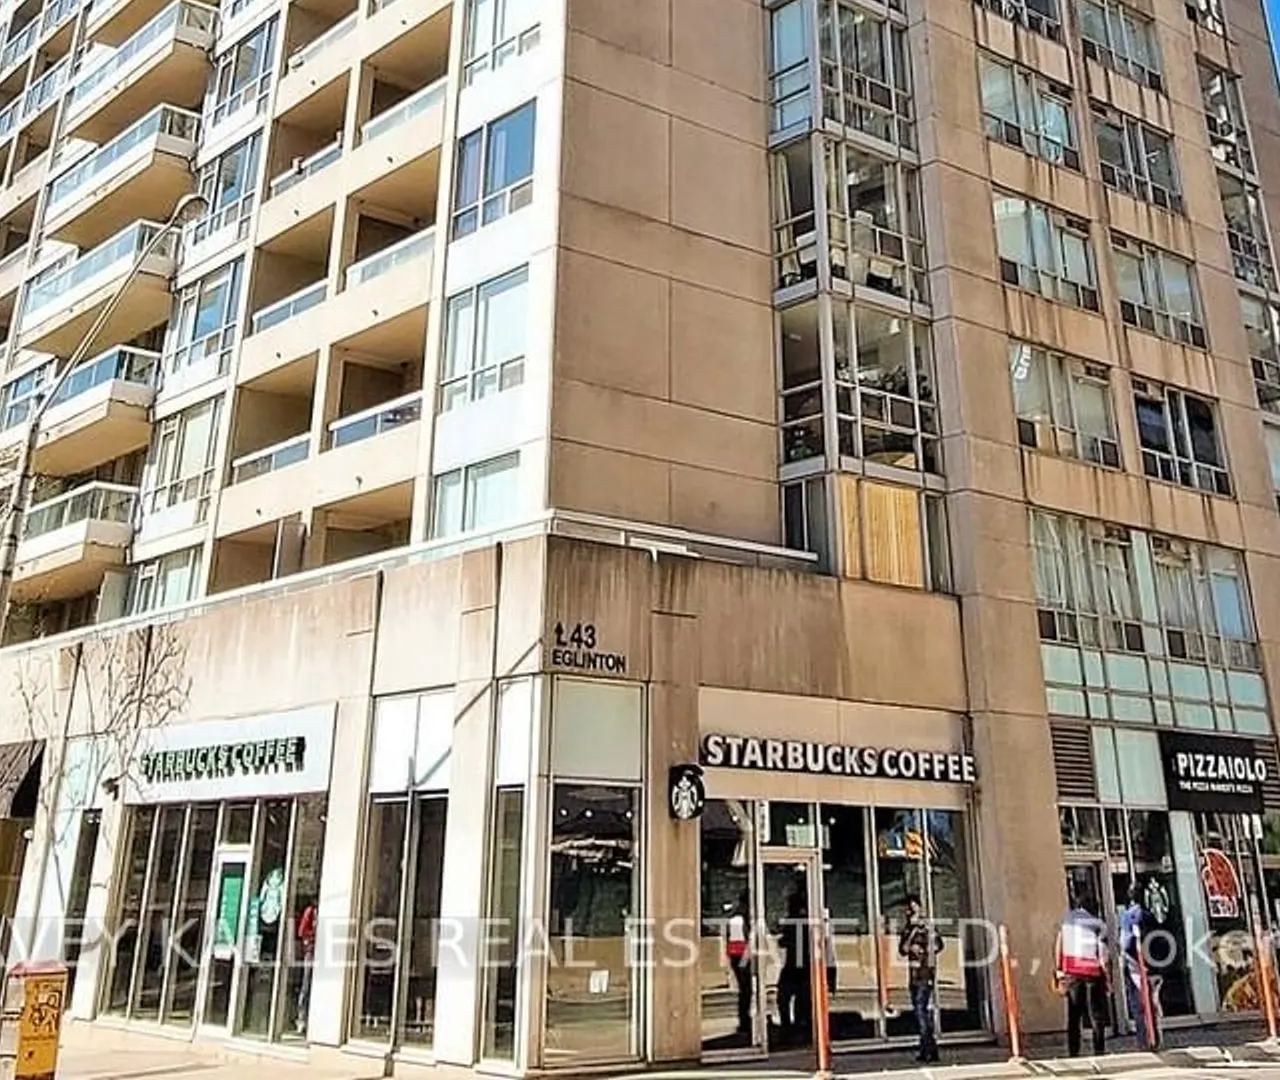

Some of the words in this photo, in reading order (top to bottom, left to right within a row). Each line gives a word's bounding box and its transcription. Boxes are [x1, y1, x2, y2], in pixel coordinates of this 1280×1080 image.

[552, 649, 626, 673] EGLINTON
[231, 737, 301, 770] COFFEE
[706, 734, 878, 776] STARBUCKS
[881, 749, 976, 782] COFFEE
[1176, 752, 1266, 781] PIZZAIOLO
